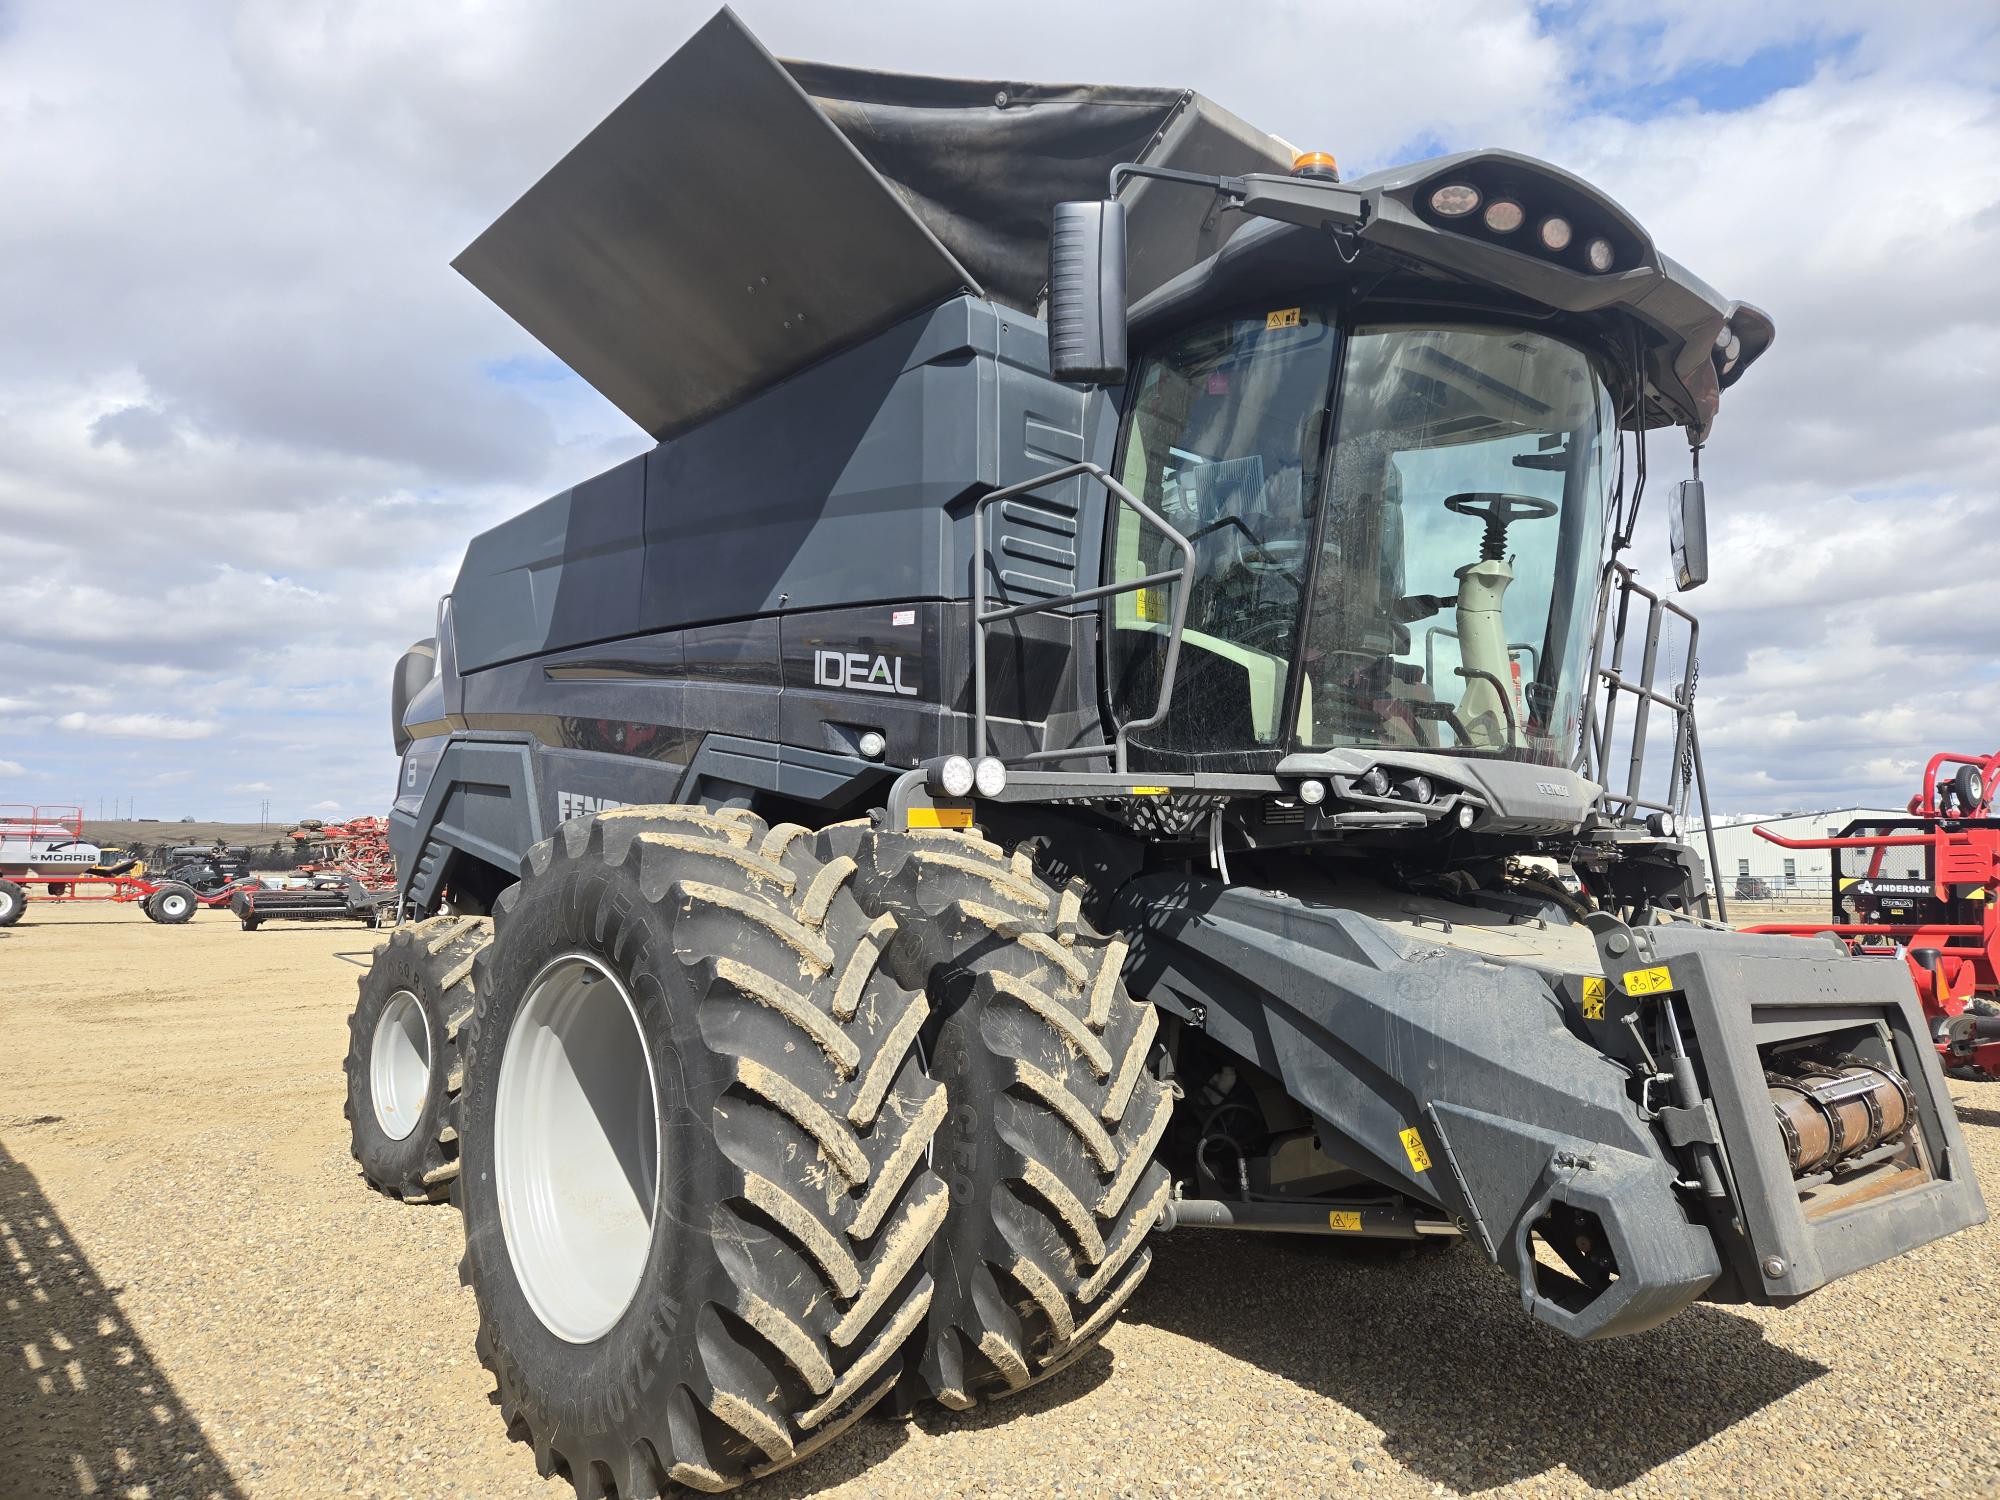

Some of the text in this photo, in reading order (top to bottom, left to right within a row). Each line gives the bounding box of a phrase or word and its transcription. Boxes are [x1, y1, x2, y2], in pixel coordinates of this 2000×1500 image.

[814, 650, 918, 696] IDEAL
[407, 758, 417, 787] 8
[1535, 782, 1569, 798] FENDT
[557, 790, 638, 823] FEN
[40, 854, 96, 862] MORRIS
[1874, 884, 1930, 894] ANDERSON
